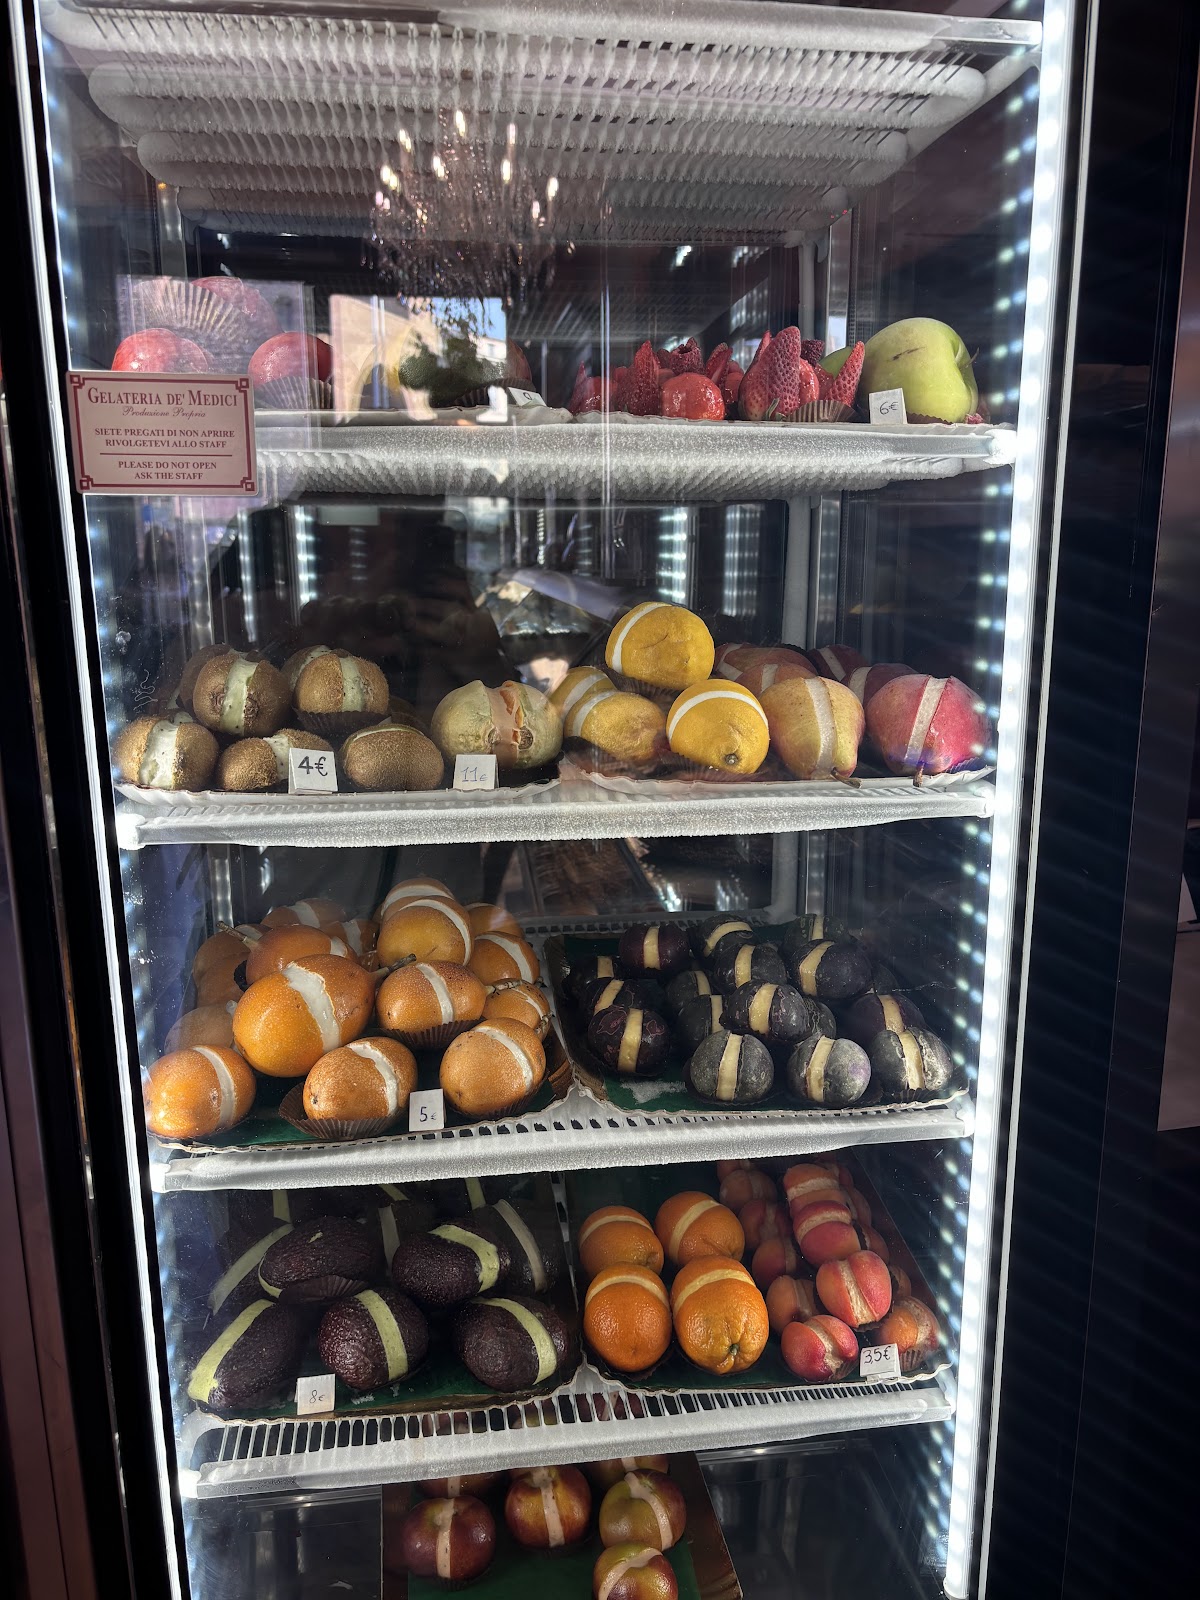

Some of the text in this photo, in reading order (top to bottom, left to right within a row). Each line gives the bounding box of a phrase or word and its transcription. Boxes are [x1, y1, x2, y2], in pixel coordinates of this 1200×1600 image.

[87, 387, 162, 405] GELATERIA
[188, 389, 238, 407] MEDICI
[122, 405, 206, 420] Produzione Propria
[94, 427, 235, 438] SIETE PREGATI DI NON APRIRE
[105, 439, 227, 449] RIVOLGETEVI ALLO STAFF
[118, 461, 217, 470] PLEASE DO NOT OPEN
[134, 472, 203, 480] ASK THE STAFF
[297, 756, 329, 777] 4€
